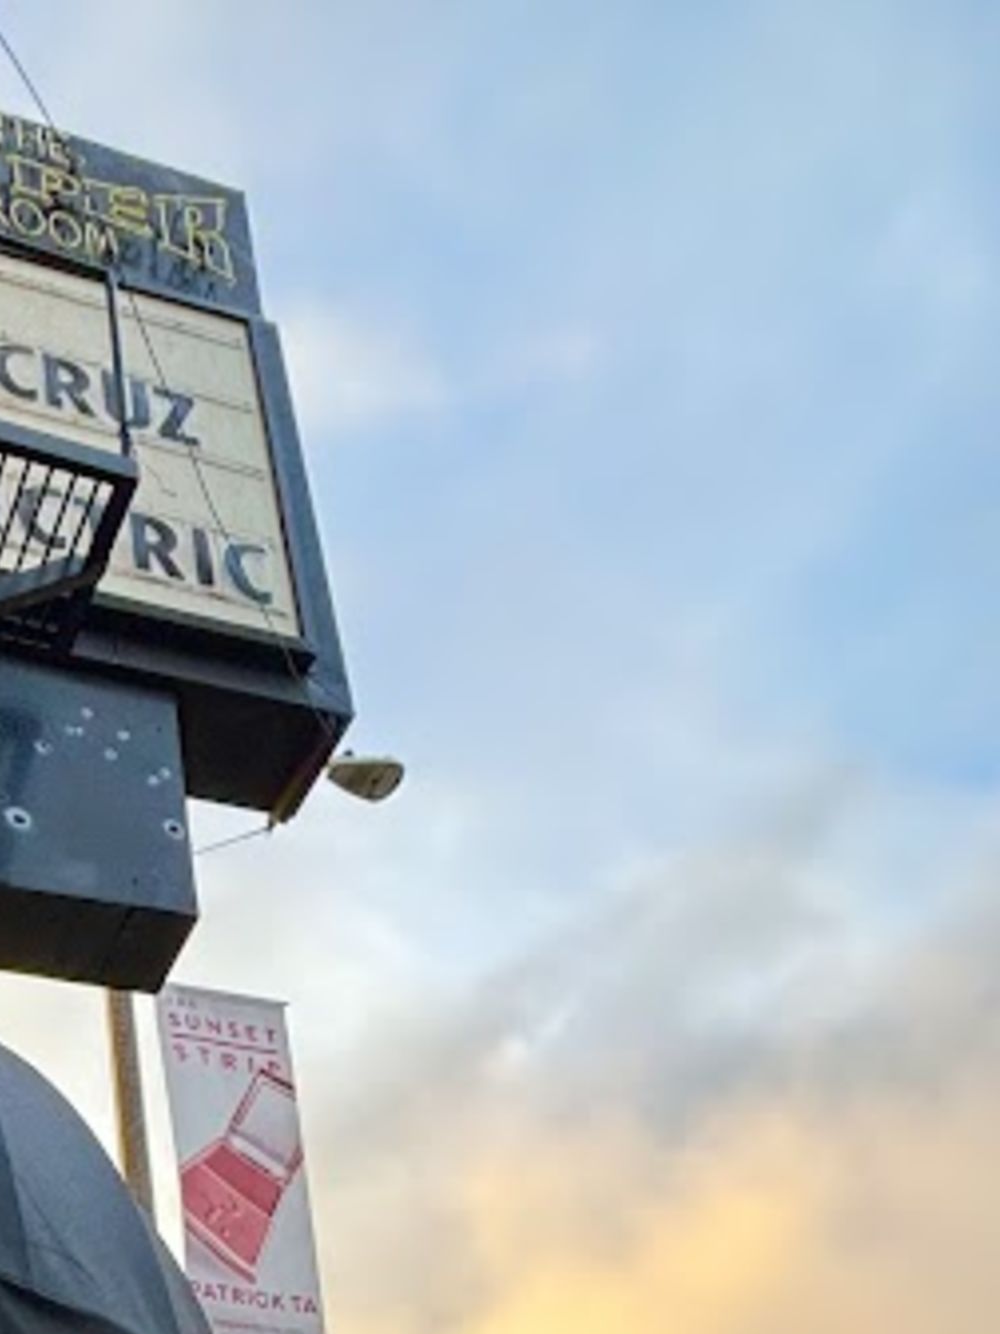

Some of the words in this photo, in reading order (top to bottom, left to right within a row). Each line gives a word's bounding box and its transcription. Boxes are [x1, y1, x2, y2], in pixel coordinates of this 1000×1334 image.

[168, 1012, 276, 1043] SUNSET
[173, 1043, 282, 1076] STRIP
[191, 1280, 285, 1312] PATRICK
[291, 1295, 318, 1314] TA
